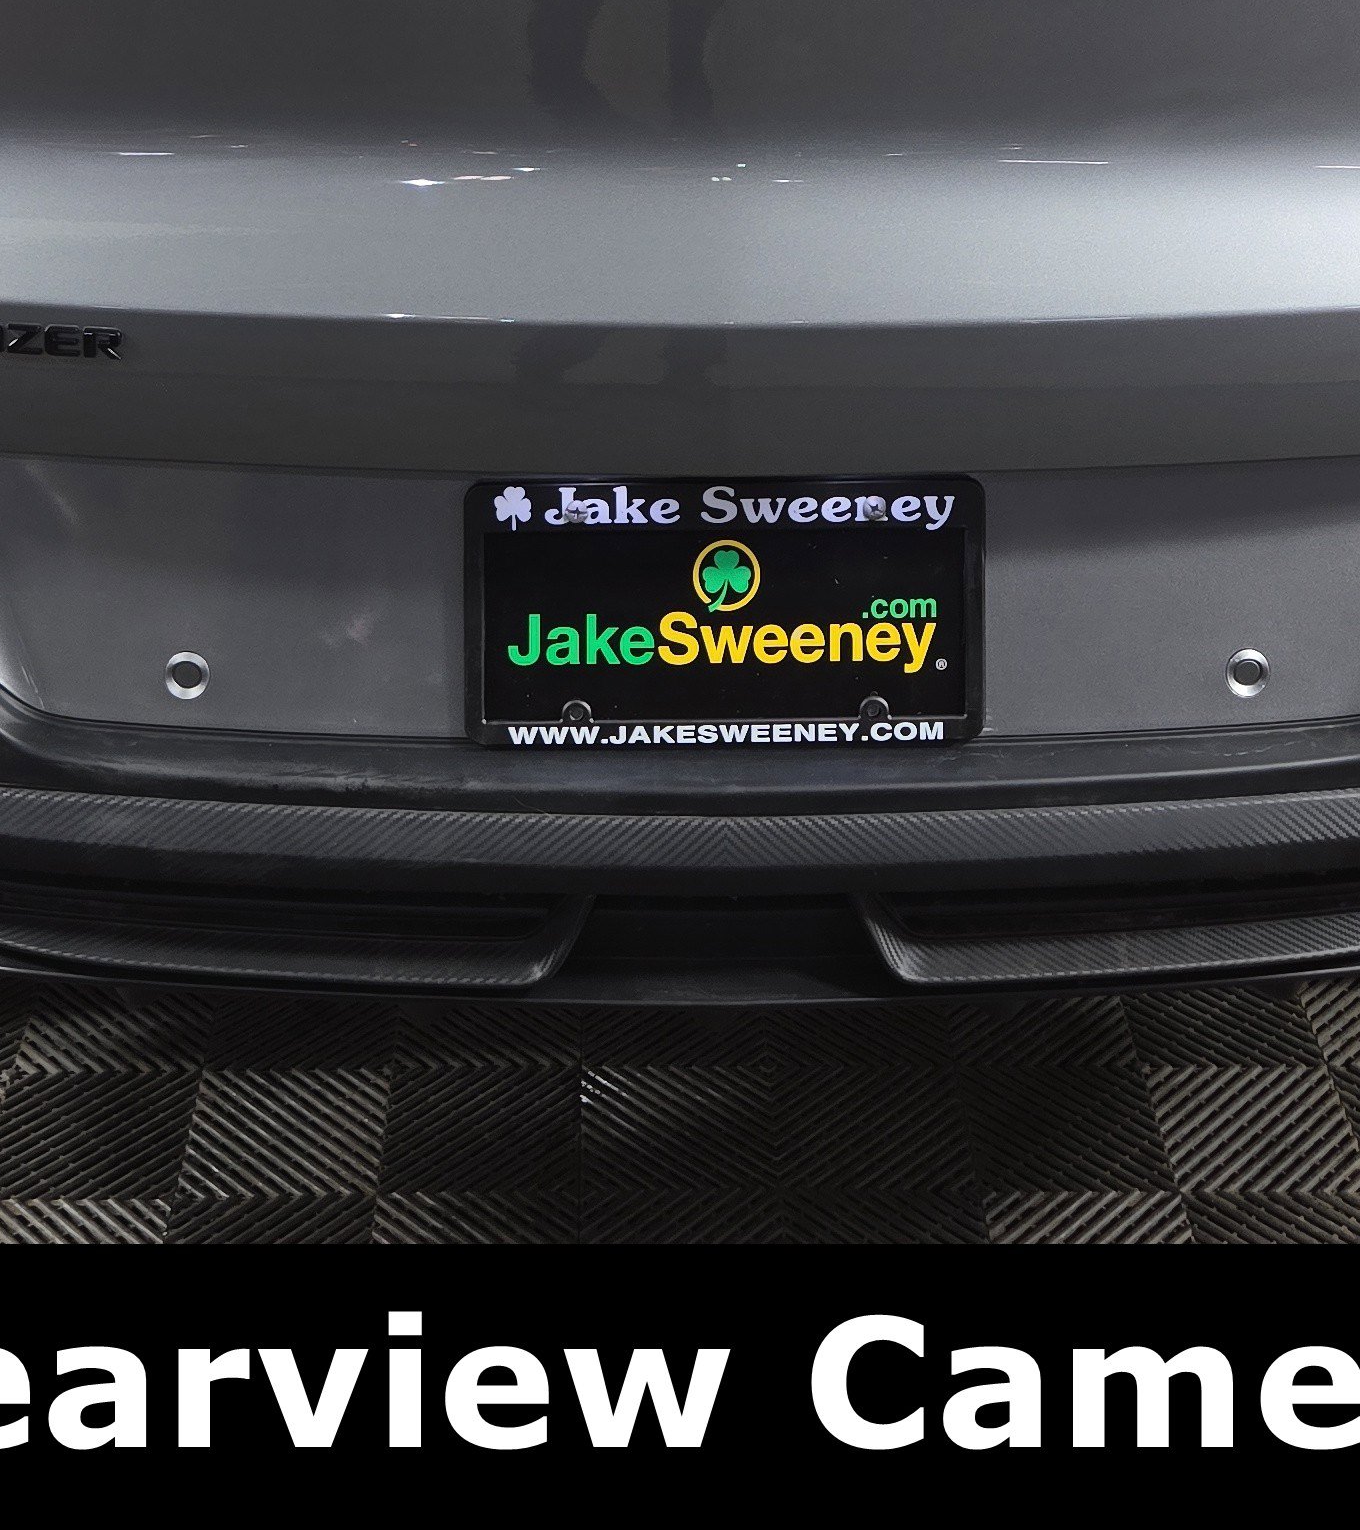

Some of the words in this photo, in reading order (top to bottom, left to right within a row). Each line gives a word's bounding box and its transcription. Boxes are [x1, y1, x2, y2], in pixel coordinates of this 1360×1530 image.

[544, 485, 681, 525] Jake
[861, 594, 937, 620] .com
[507, 611, 937, 674] JakeSweeney
[507, 721, 945, 747] WWW.JAKESWEENEY.COM
